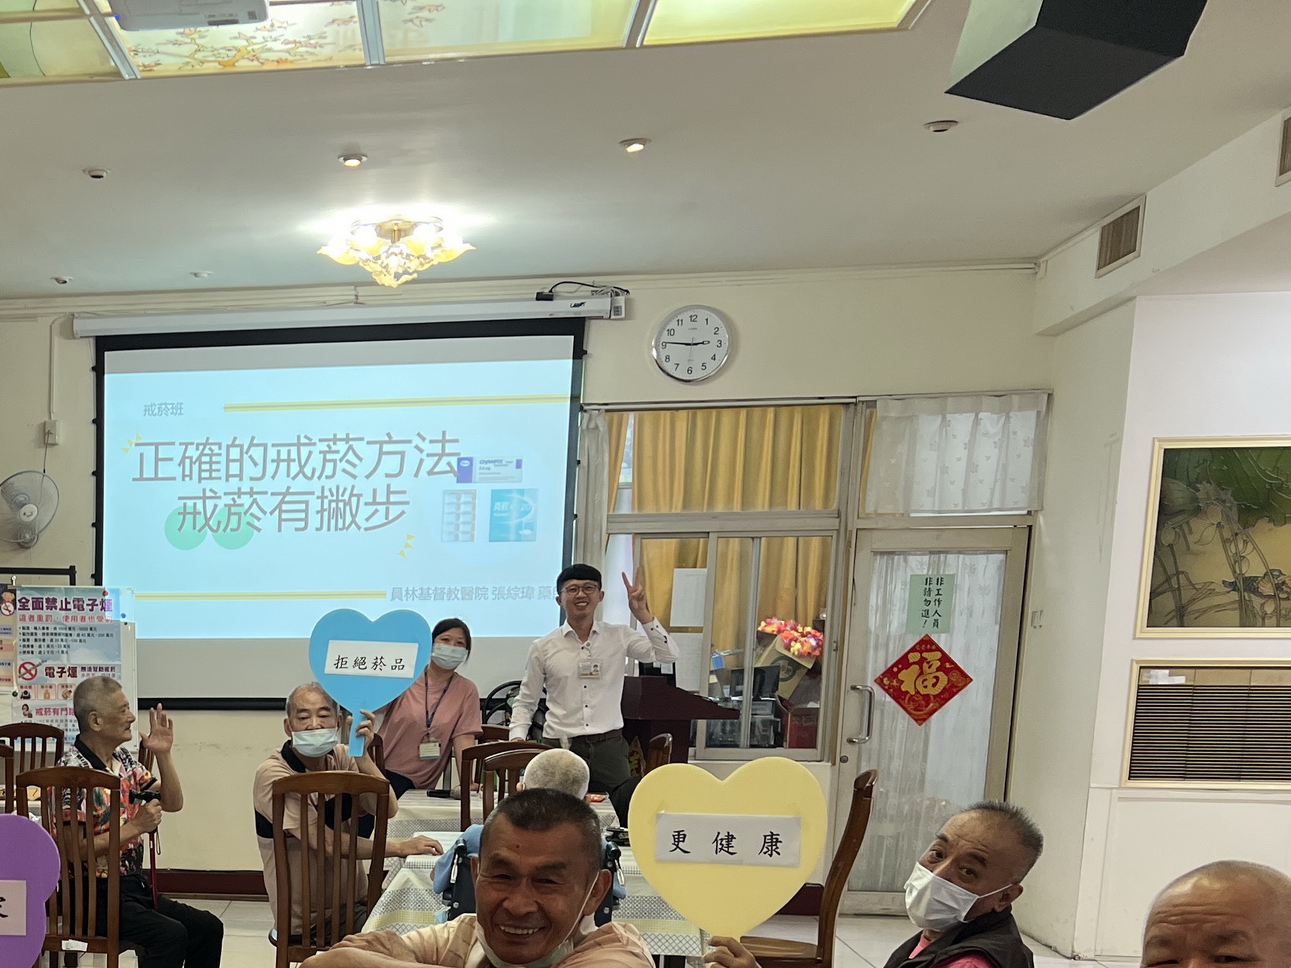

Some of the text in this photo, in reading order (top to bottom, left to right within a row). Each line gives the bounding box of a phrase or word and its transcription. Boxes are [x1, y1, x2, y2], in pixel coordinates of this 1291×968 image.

[676, 318, 683, 326] 11
[689, 314, 698, 322] 12
[705, 317, 709, 325] 1
[666, 328, 675, 336] 10
[713, 327, 720, 335] 2
[661, 341, 667, 349] 9
[716, 339, 723, 348] 3
[664, 355, 670, 363] 8
[711, 353, 717, 361] 4
[674, 363, 679, 371] 7
[687, 366, 693, 375] 6
[701, 362, 707, 371] 5
[143, 402, 184, 417] 戒菸班
[131, 430, 461, 482] 正確的戒菸方法
[176, 483, 410, 534] 戒菸有撇步
[391, 586, 489, 601] 員林基督教醫院
[17, 597, 113, 612] 全面禁止電子煙
[931, 576, 945, 629] 非工作人員
[333, 655, 406, 671] 拒絕菸品
[44, 666, 78, 679] 電子煙
[897, 651, 949, 696] 福
[669, 829, 784, 858] 更健康
